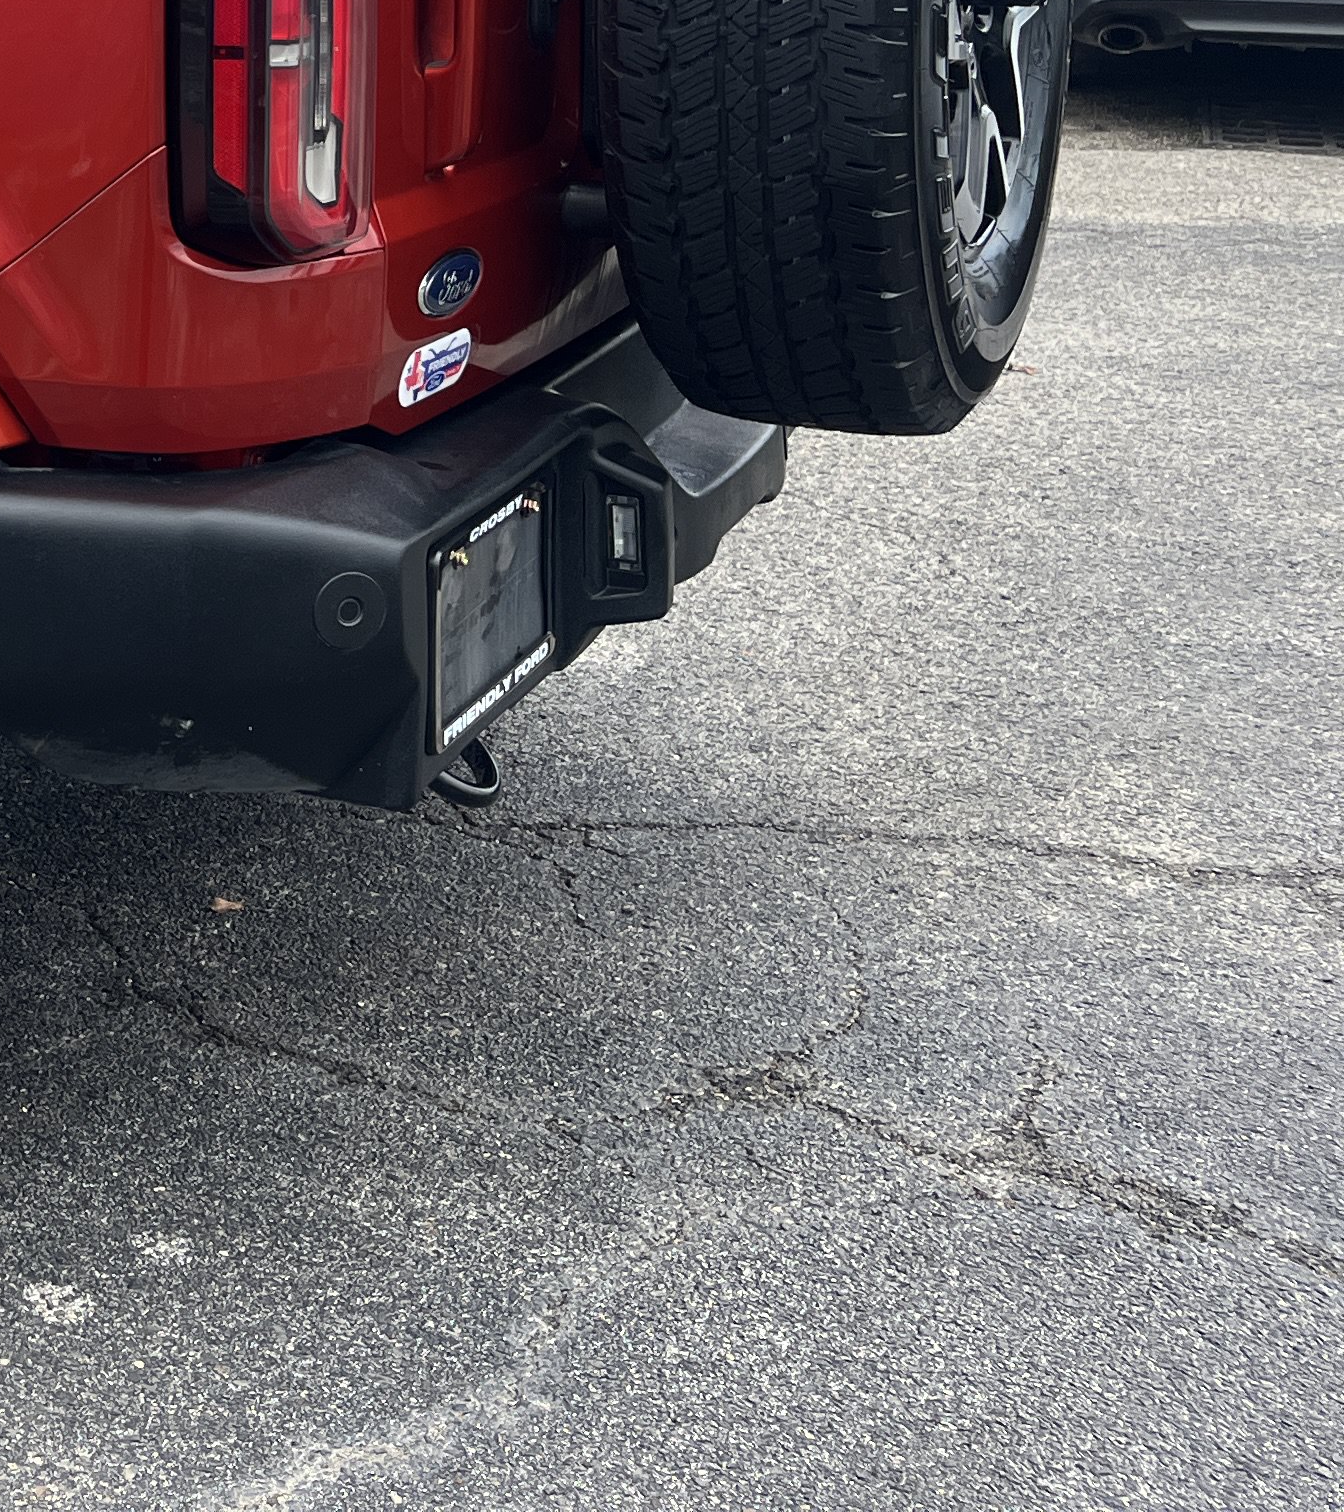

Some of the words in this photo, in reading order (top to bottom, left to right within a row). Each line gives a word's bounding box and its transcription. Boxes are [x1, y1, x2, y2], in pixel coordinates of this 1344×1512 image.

[438, 264, 474, 305] Ford
[469, 494, 524, 543] CROSBY
[443, 675, 512, 746] FRIENDLY
[514, 641, 550, 684] FORD
